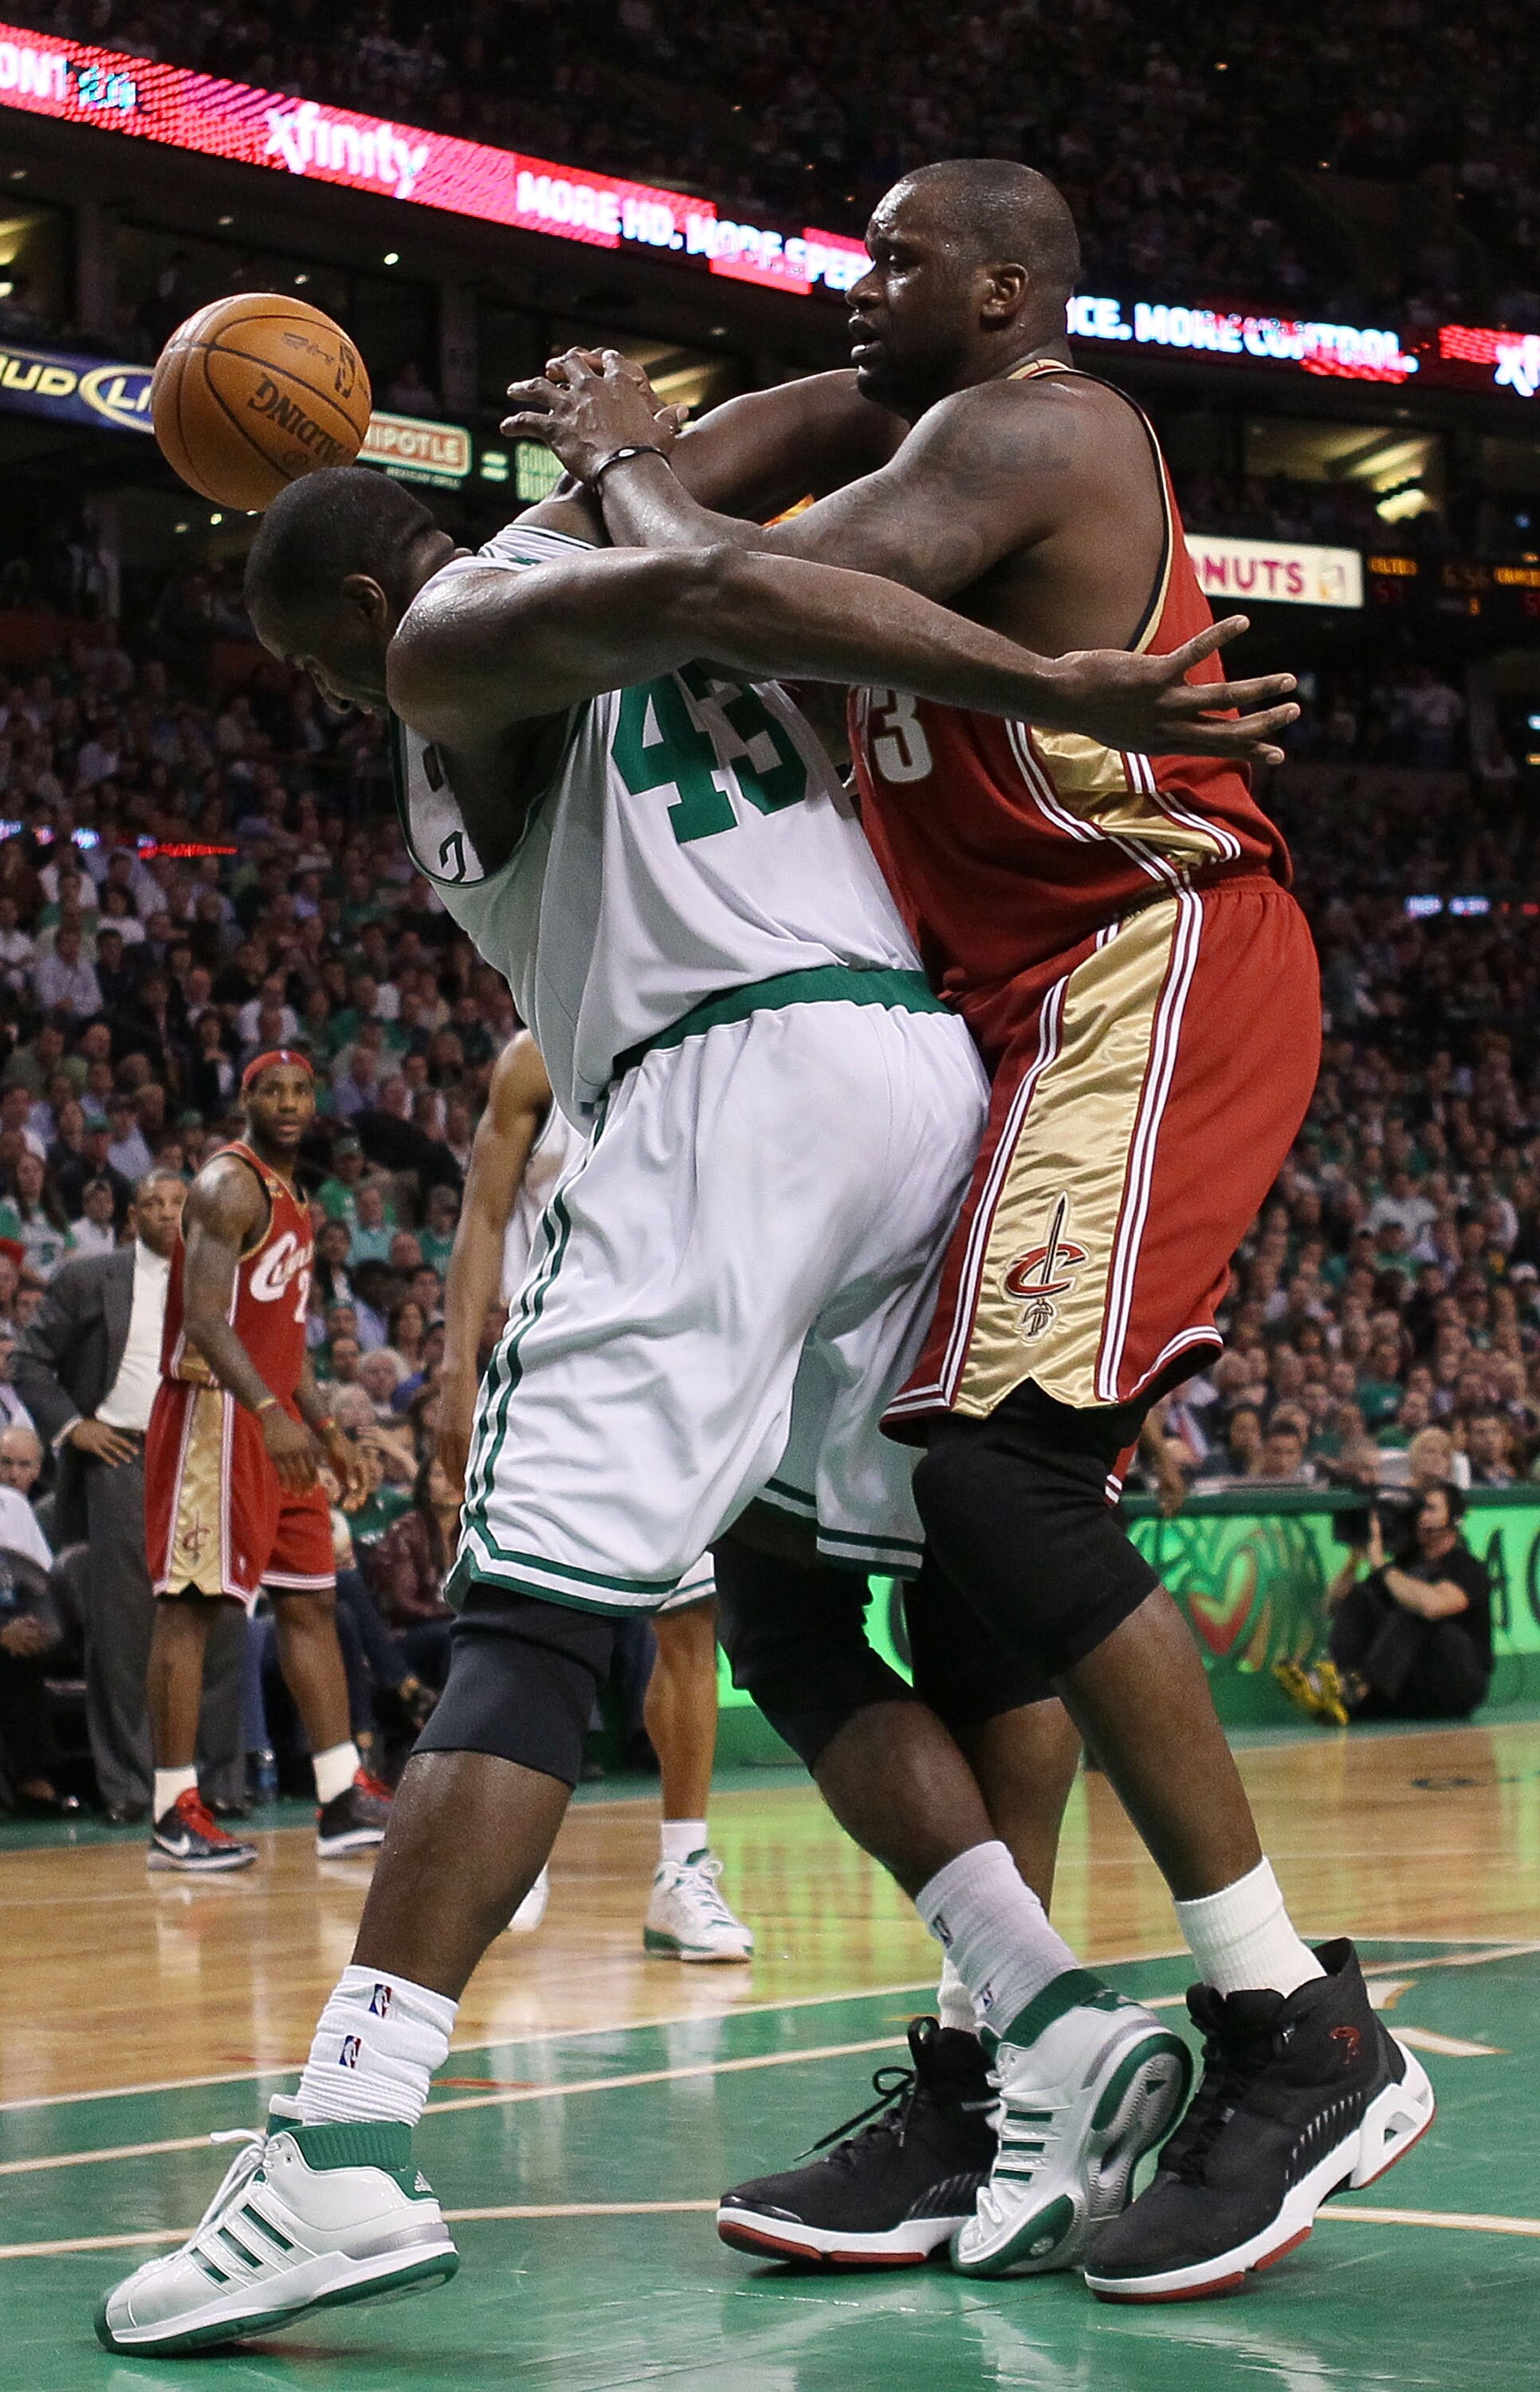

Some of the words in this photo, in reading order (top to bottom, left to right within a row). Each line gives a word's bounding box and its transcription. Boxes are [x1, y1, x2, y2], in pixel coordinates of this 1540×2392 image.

[517, 171, 622, 235] MORE
[0, 355, 78, 396] UD
[1193, 554, 1303, 595] NUTS
[613, 658, 807, 845] 43
